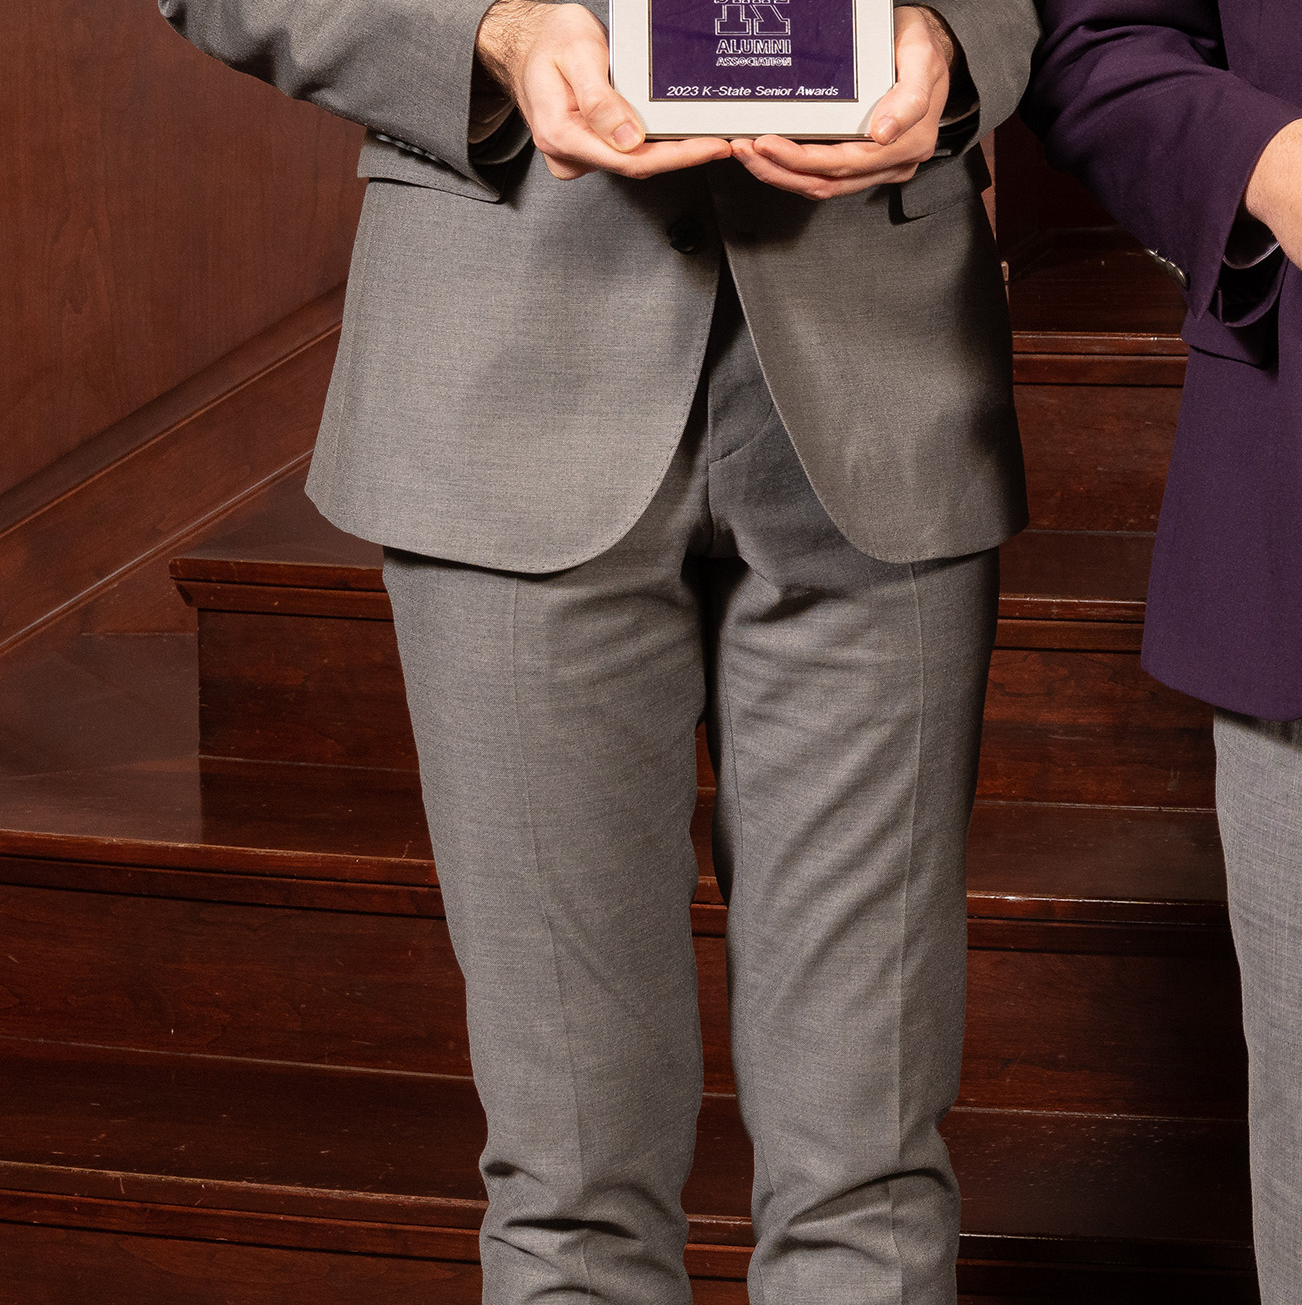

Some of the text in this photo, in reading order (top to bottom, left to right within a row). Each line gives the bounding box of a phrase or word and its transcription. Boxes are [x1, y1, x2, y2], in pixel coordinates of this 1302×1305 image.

[716, 39, 792, 55] ALUMNI
[715, 56, 792, 67] ASSOCIATION
[666, 85, 839, 96] 2023 K-State Senior Awards
